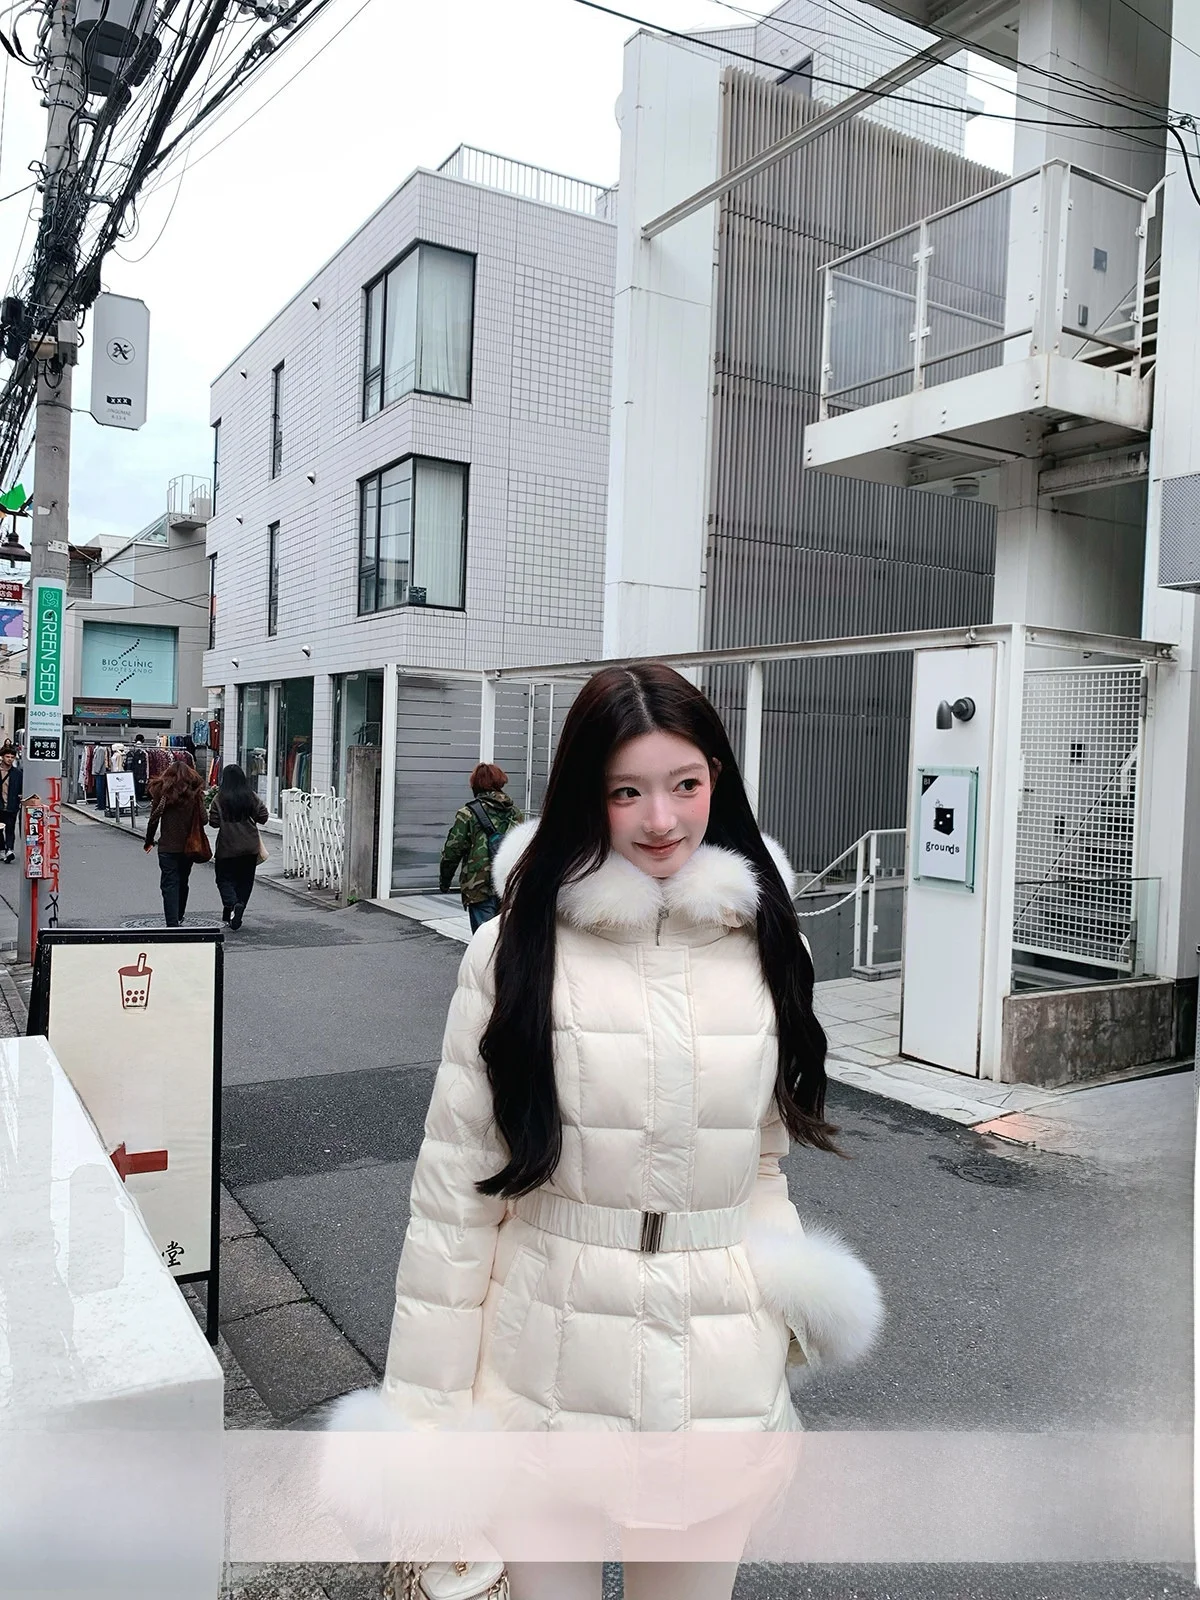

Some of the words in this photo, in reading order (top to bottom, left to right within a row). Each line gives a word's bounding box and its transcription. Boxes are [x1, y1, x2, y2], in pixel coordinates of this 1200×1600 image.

[41, 609, 58, 660] GREEN
[102, 666, 153, 674] OMOTESANDO
[121, 660, 153, 668] CLINIC
[40, 663, 56, 702] SEED
[34, 741, 57, 749] 神宮前
[925, 842, 960, 855] grounds
[162, 1240, 185, 1268] 堂
